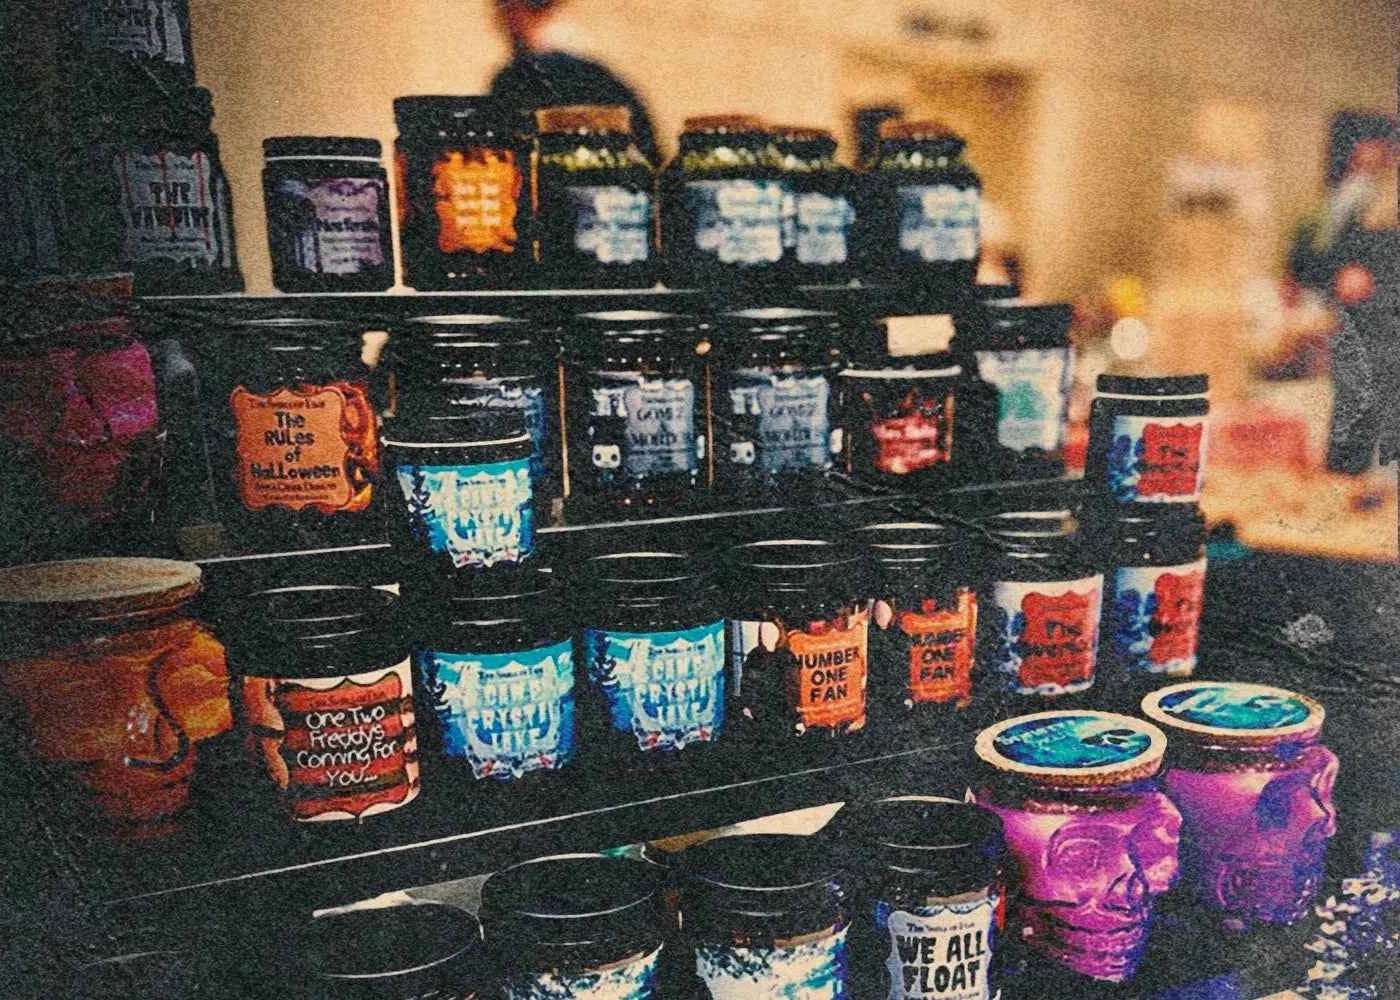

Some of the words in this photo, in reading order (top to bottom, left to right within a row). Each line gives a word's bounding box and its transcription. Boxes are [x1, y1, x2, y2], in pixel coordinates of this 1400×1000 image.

[274, 411, 306, 428] The
[284, 445, 302, 462] of
[921, 648, 955, 664] ONE
[810, 665, 848, 686] ONE
[919, 666, 956, 681] FAN
[809, 685, 849, 703] FAN
[306, 711, 345, 729] One
[348, 705, 385, 725] Two
[297, 746, 371, 770] Coming
[373, 740, 397, 759] For
[895, 934, 937, 964] WE
[946, 930, 986, 963] ALL
[902, 959, 980, 993] FLOAT
